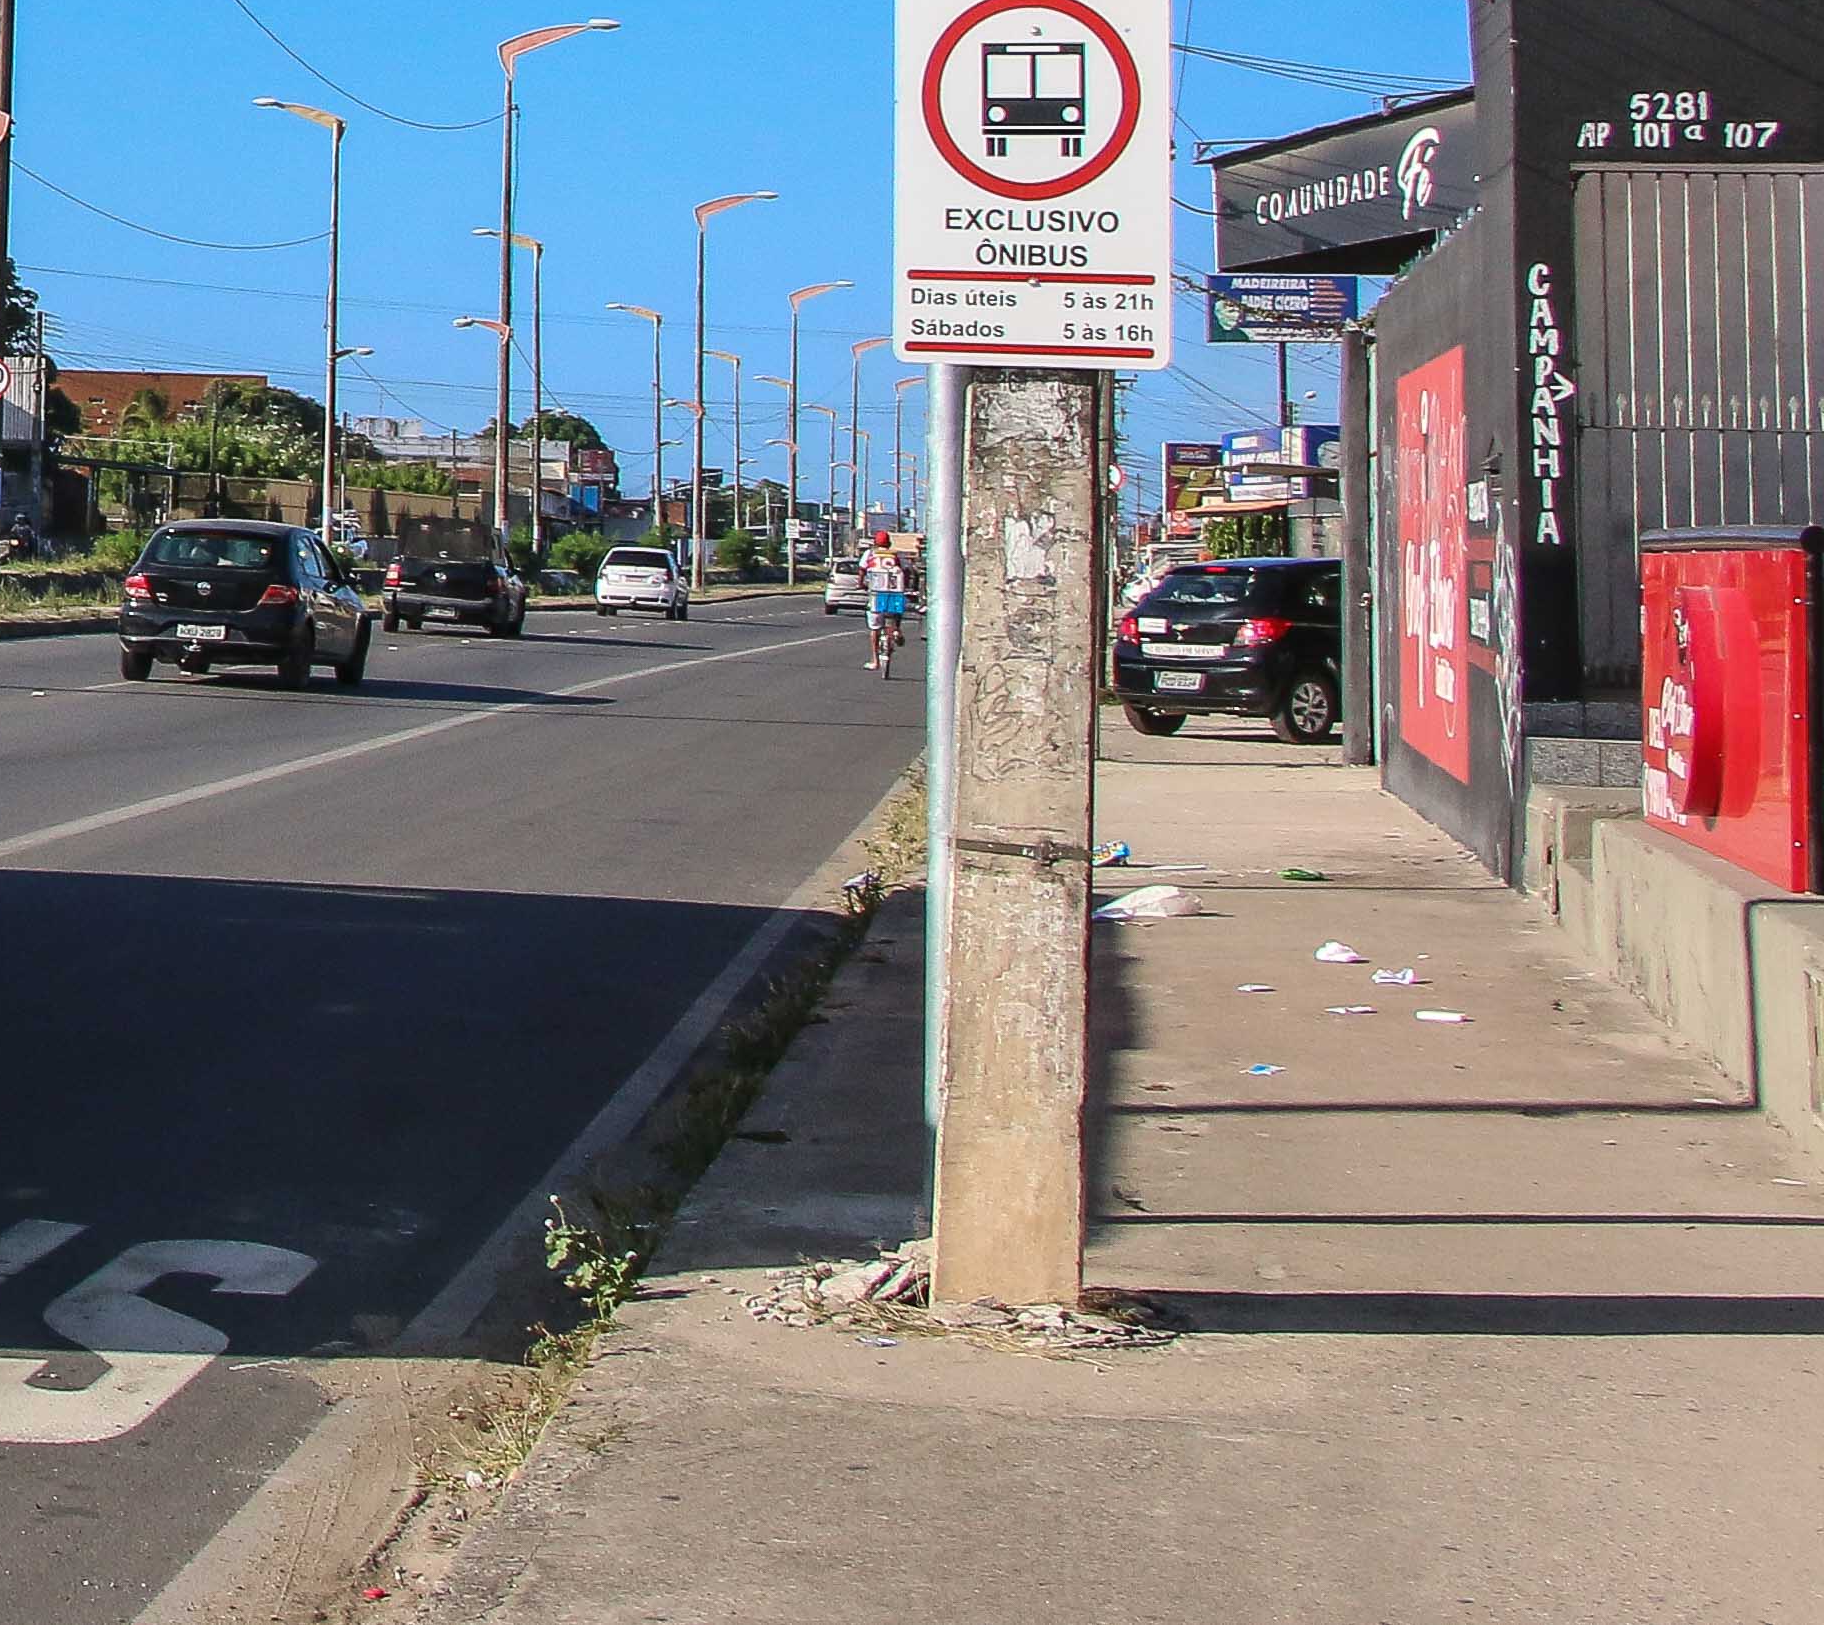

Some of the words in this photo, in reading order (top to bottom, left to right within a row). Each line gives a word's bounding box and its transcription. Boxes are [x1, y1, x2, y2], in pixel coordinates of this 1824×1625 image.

[1629, 90, 1710, 122] 5281
[1577, 122, 1611, 148] AP
[1632, 122, 1671, 148] 101
[1723, 122, 1778, 148] 107
[1255, 165, 1391, 225] COMUNIDADE
[945, 208, 1120, 233] EXCLUSIVO
[975, 238, 1089, 267] ÔNIBUS
[911, 287, 958, 306] Dias
[965, 288, 1018, 308] úteis
[1063, 292, 1076, 309] 5
[1082, 292, 1108, 310] às
[1114, 293, 1154, 310] 21h
[911, 318, 1006, 338] Sábados
[1063, 323, 1076, 340] 5
[1082, 323, 1108, 341] às
[1115, 325, 1154, 342] 16h
[1526, 263, 1561, 544] CAMPANHIA
